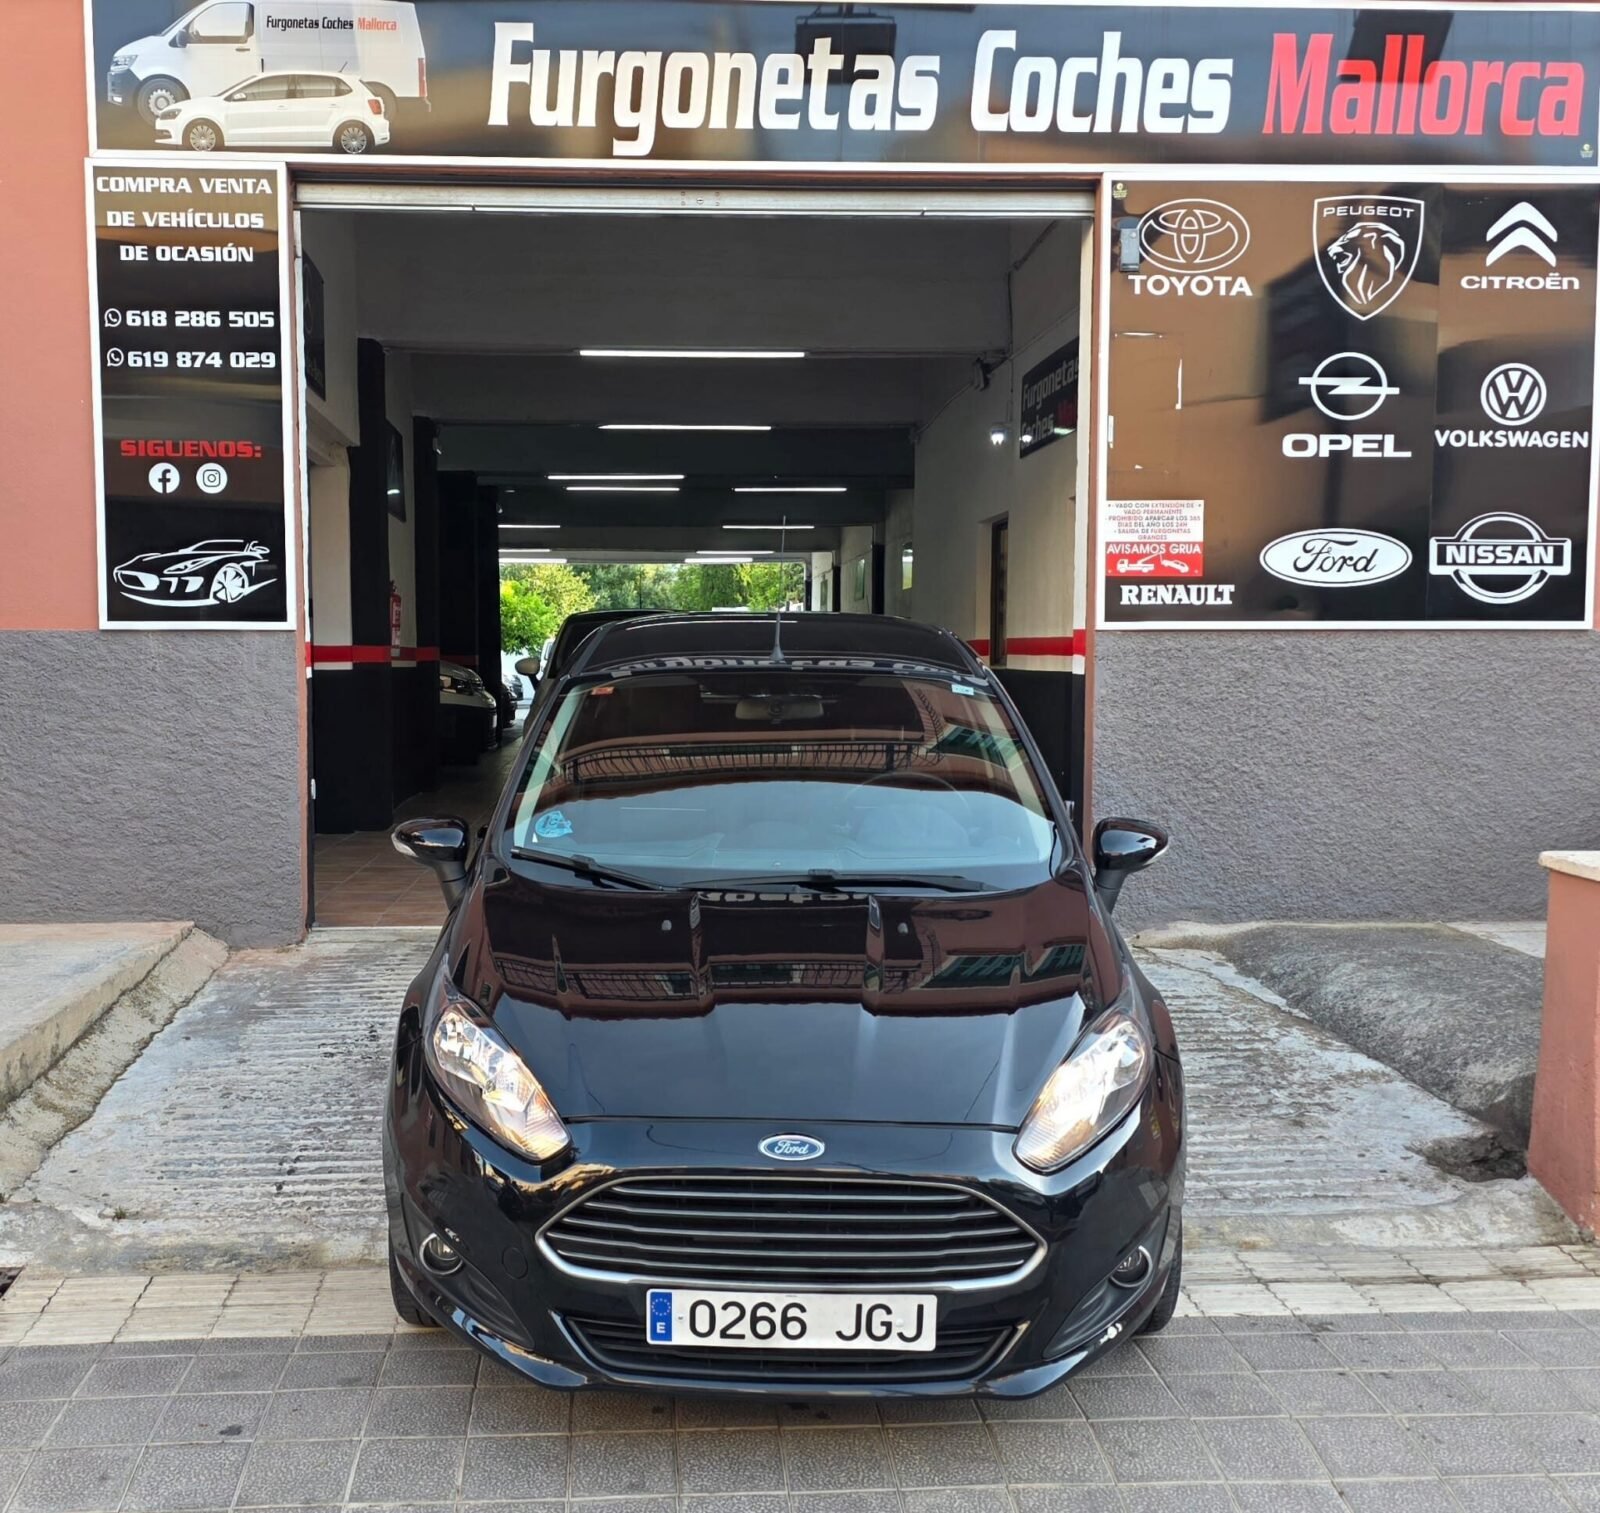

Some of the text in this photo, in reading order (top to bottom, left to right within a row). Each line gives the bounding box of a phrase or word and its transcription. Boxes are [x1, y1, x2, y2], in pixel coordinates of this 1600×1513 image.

[266, 15, 397, 31] Furgonetas Coches Mallorca
[487, 22, 1585, 156] Furgonetas Coches Mallorca
[96, 176, 272, 194] COMPRA VENTA
[106, 208, 264, 228] DE VEHÍCULOS
[1323, 205, 1415, 218] PEUGEOT
[120, 243, 254, 262] DE OCASIÓN
[1127, 275, 1253, 296] TOYOTA
[126, 310, 275, 328] 618 286 505
[127, 351, 276, 368] 619 874 029
[1282, 433, 1412, 457] OPEL
[1434, 429, 1589, 448] VOLKSWAGEN
[120, 440, 262, 458] SIGUENOS:
[1106, 543, 1202, 554] AVISAMOS GRUA
[1293, 538, 1379, 573] Ford
[1445, 545, 1554, 564] NISSAN
[1120, 584, 1235, 605] RENAULT
[773, 1139, 809, 1156] Ford
[656, 1321, 666, 1334] E
[689, 1299, 924, 1343] 0266 JGJ
